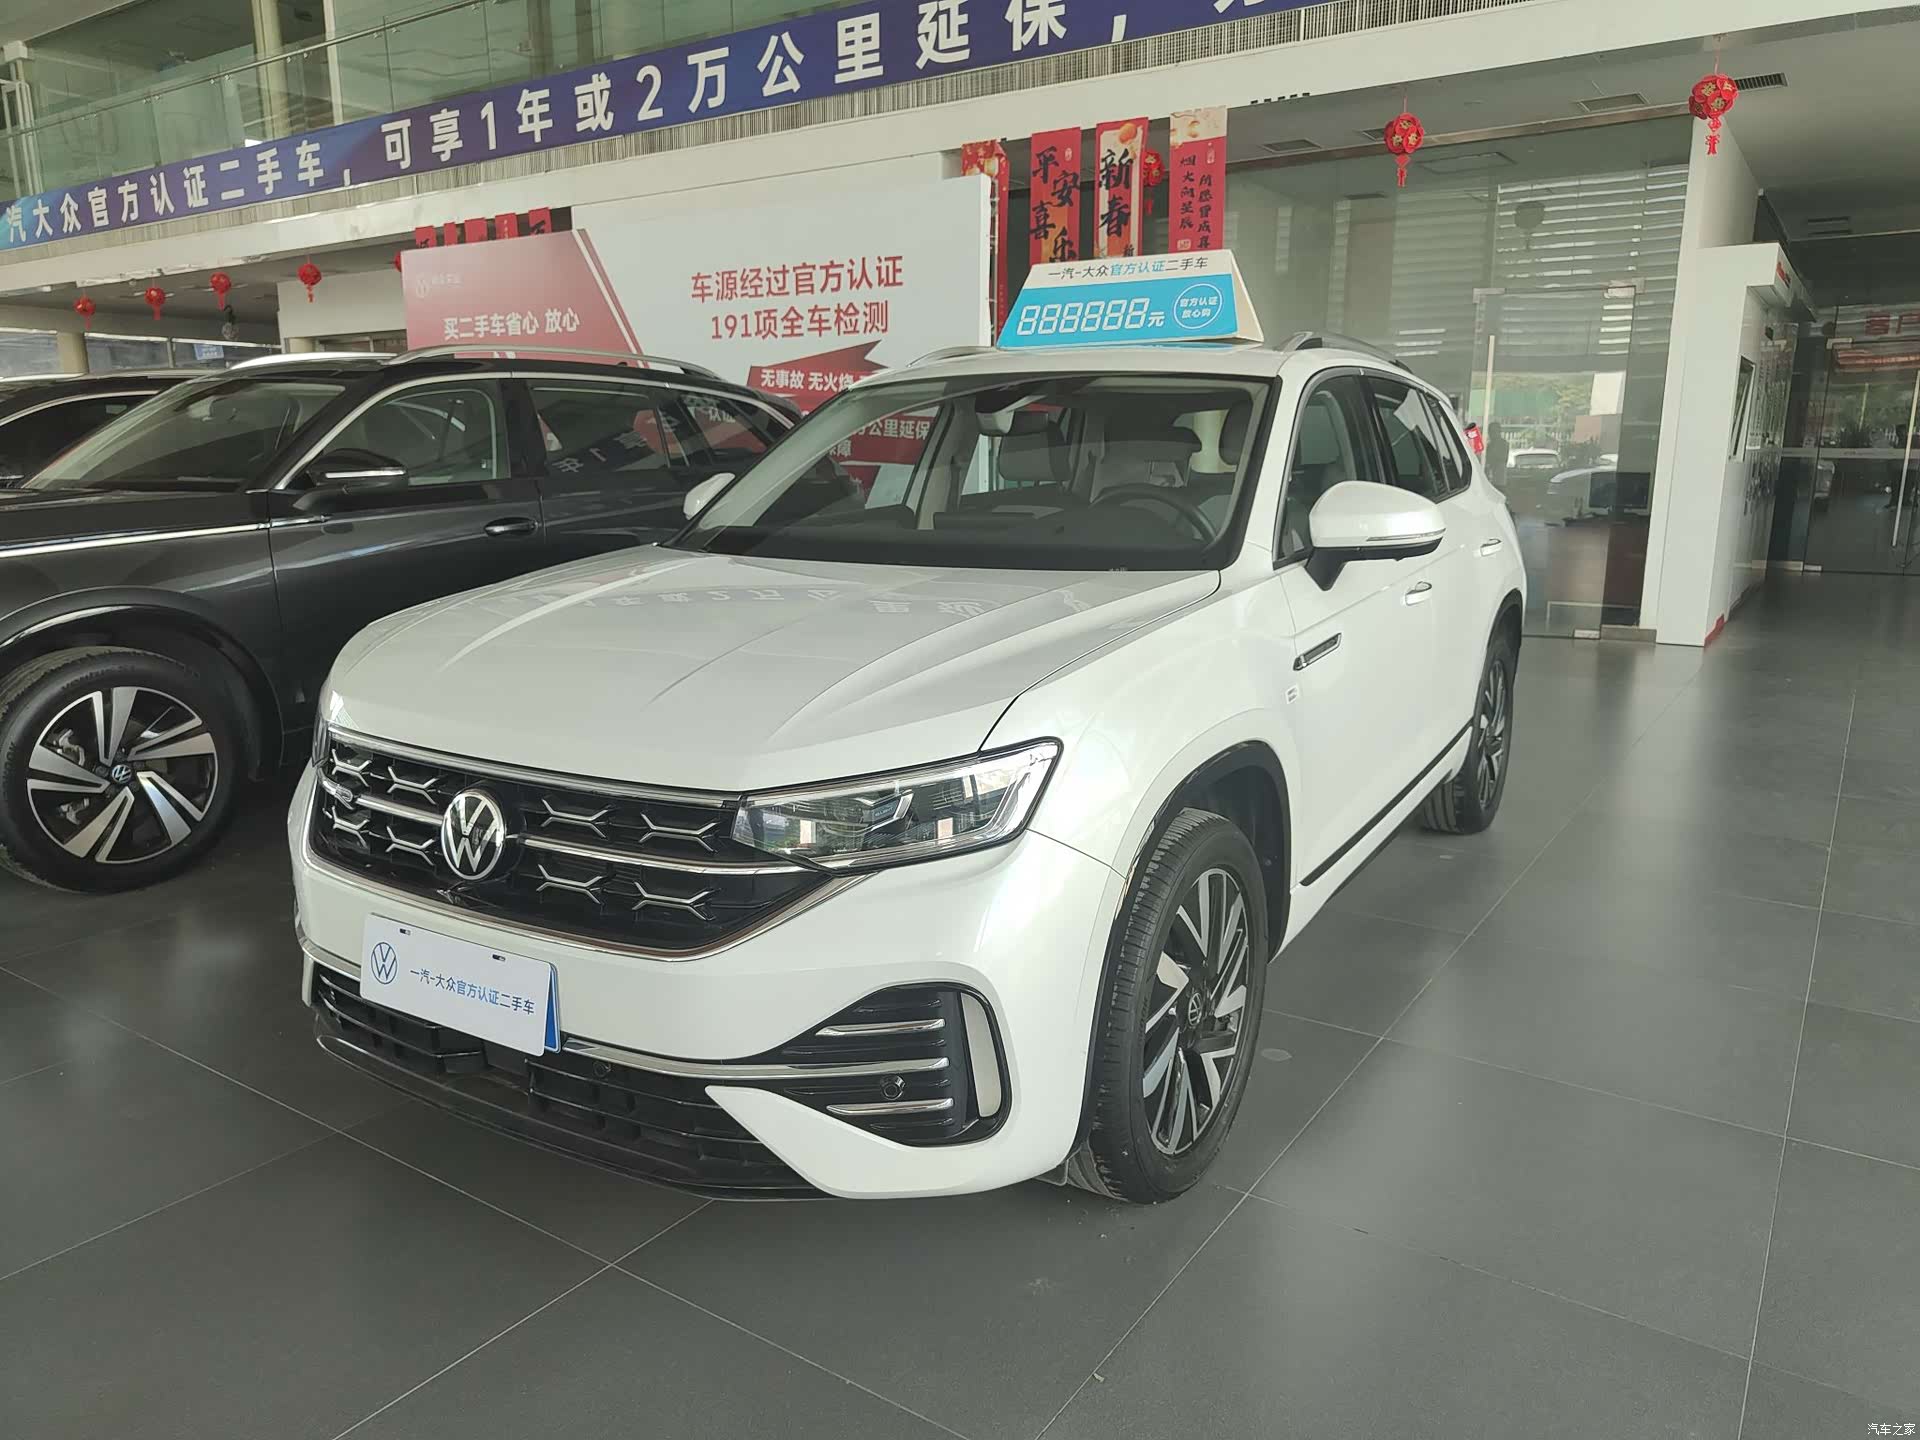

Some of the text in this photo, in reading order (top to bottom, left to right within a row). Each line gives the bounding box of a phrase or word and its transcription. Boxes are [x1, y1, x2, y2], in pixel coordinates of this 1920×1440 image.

[1099, 148, 1133, 237] 新春
[691, 255, 904, 304] 车源经过官方认证
[444, 307, 580, 341] 买二手车省心 放心
[711, 300, 889, 340] 191项全车检测
[761, 368, 804, 389] 无事故
[410, 968, 535, 1015] 一汽-大众官方认证二手车
